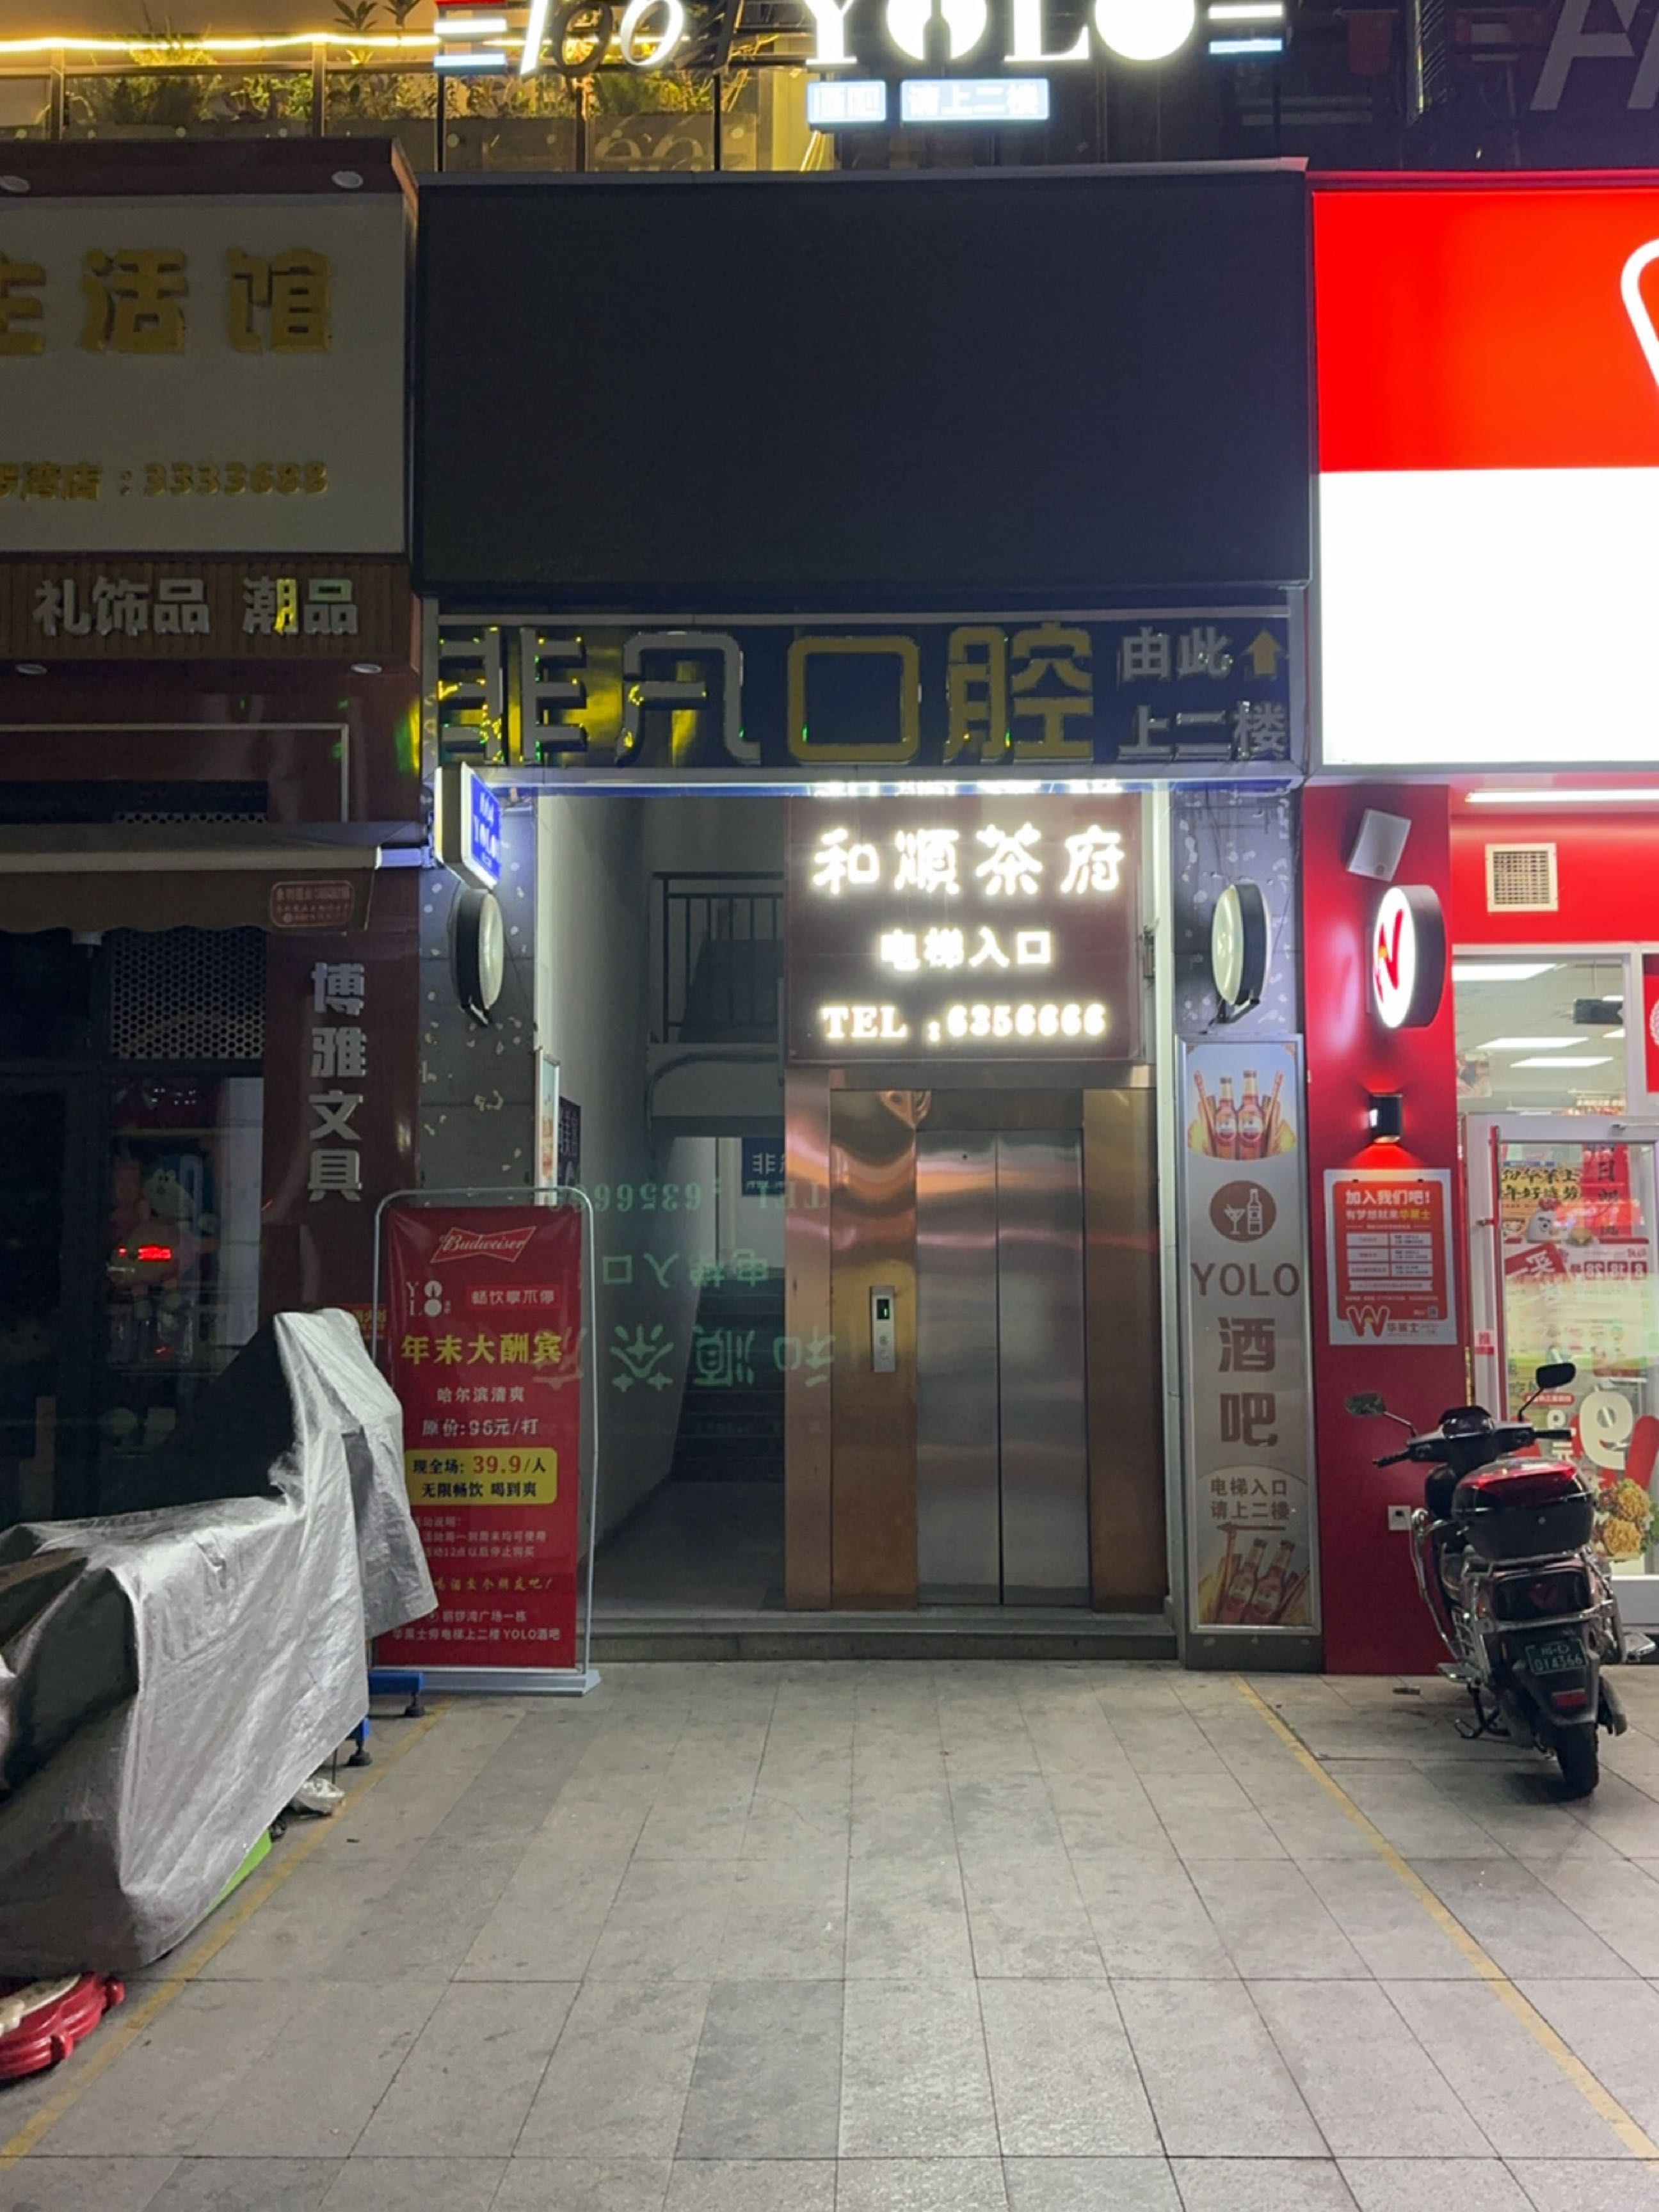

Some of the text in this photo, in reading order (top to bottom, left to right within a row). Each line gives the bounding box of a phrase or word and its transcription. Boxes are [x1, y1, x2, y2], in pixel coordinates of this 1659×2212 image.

[32, 577, 358, 637] 礼饰品 潮品
[1119, 626, 1231, 683] 由此
[438, 622, 1094, 766] 非凡口腔
[1118, 700, 1288, 760] 上二楼
[879, 927, 1052, 971] 电梯入口
[822, 1006, 908, 1039] TEL
[307, 962, 367, 1202] 博雅文具
[753, 1152, 784, 1175] 非
[439, 1233, 525, 1253] Budweiser
[1190, 1262, 1300, 1297] YOLO
[401, 1332, 563, 1365] 年末大酬宾
[437, 1386, 525, 1404] 哈尔滨清爽
[1218, 1317, 1278, 1447] 酒吧
[472, 1455, 546, 1474] 39.9/人
[422, 1482, 537, 1498] 无限畅饮 喝到爽
[1210, 1478, 1288, 1498] 电梯入口
[1210, 1501, 1290, 1521] 请上二楼
